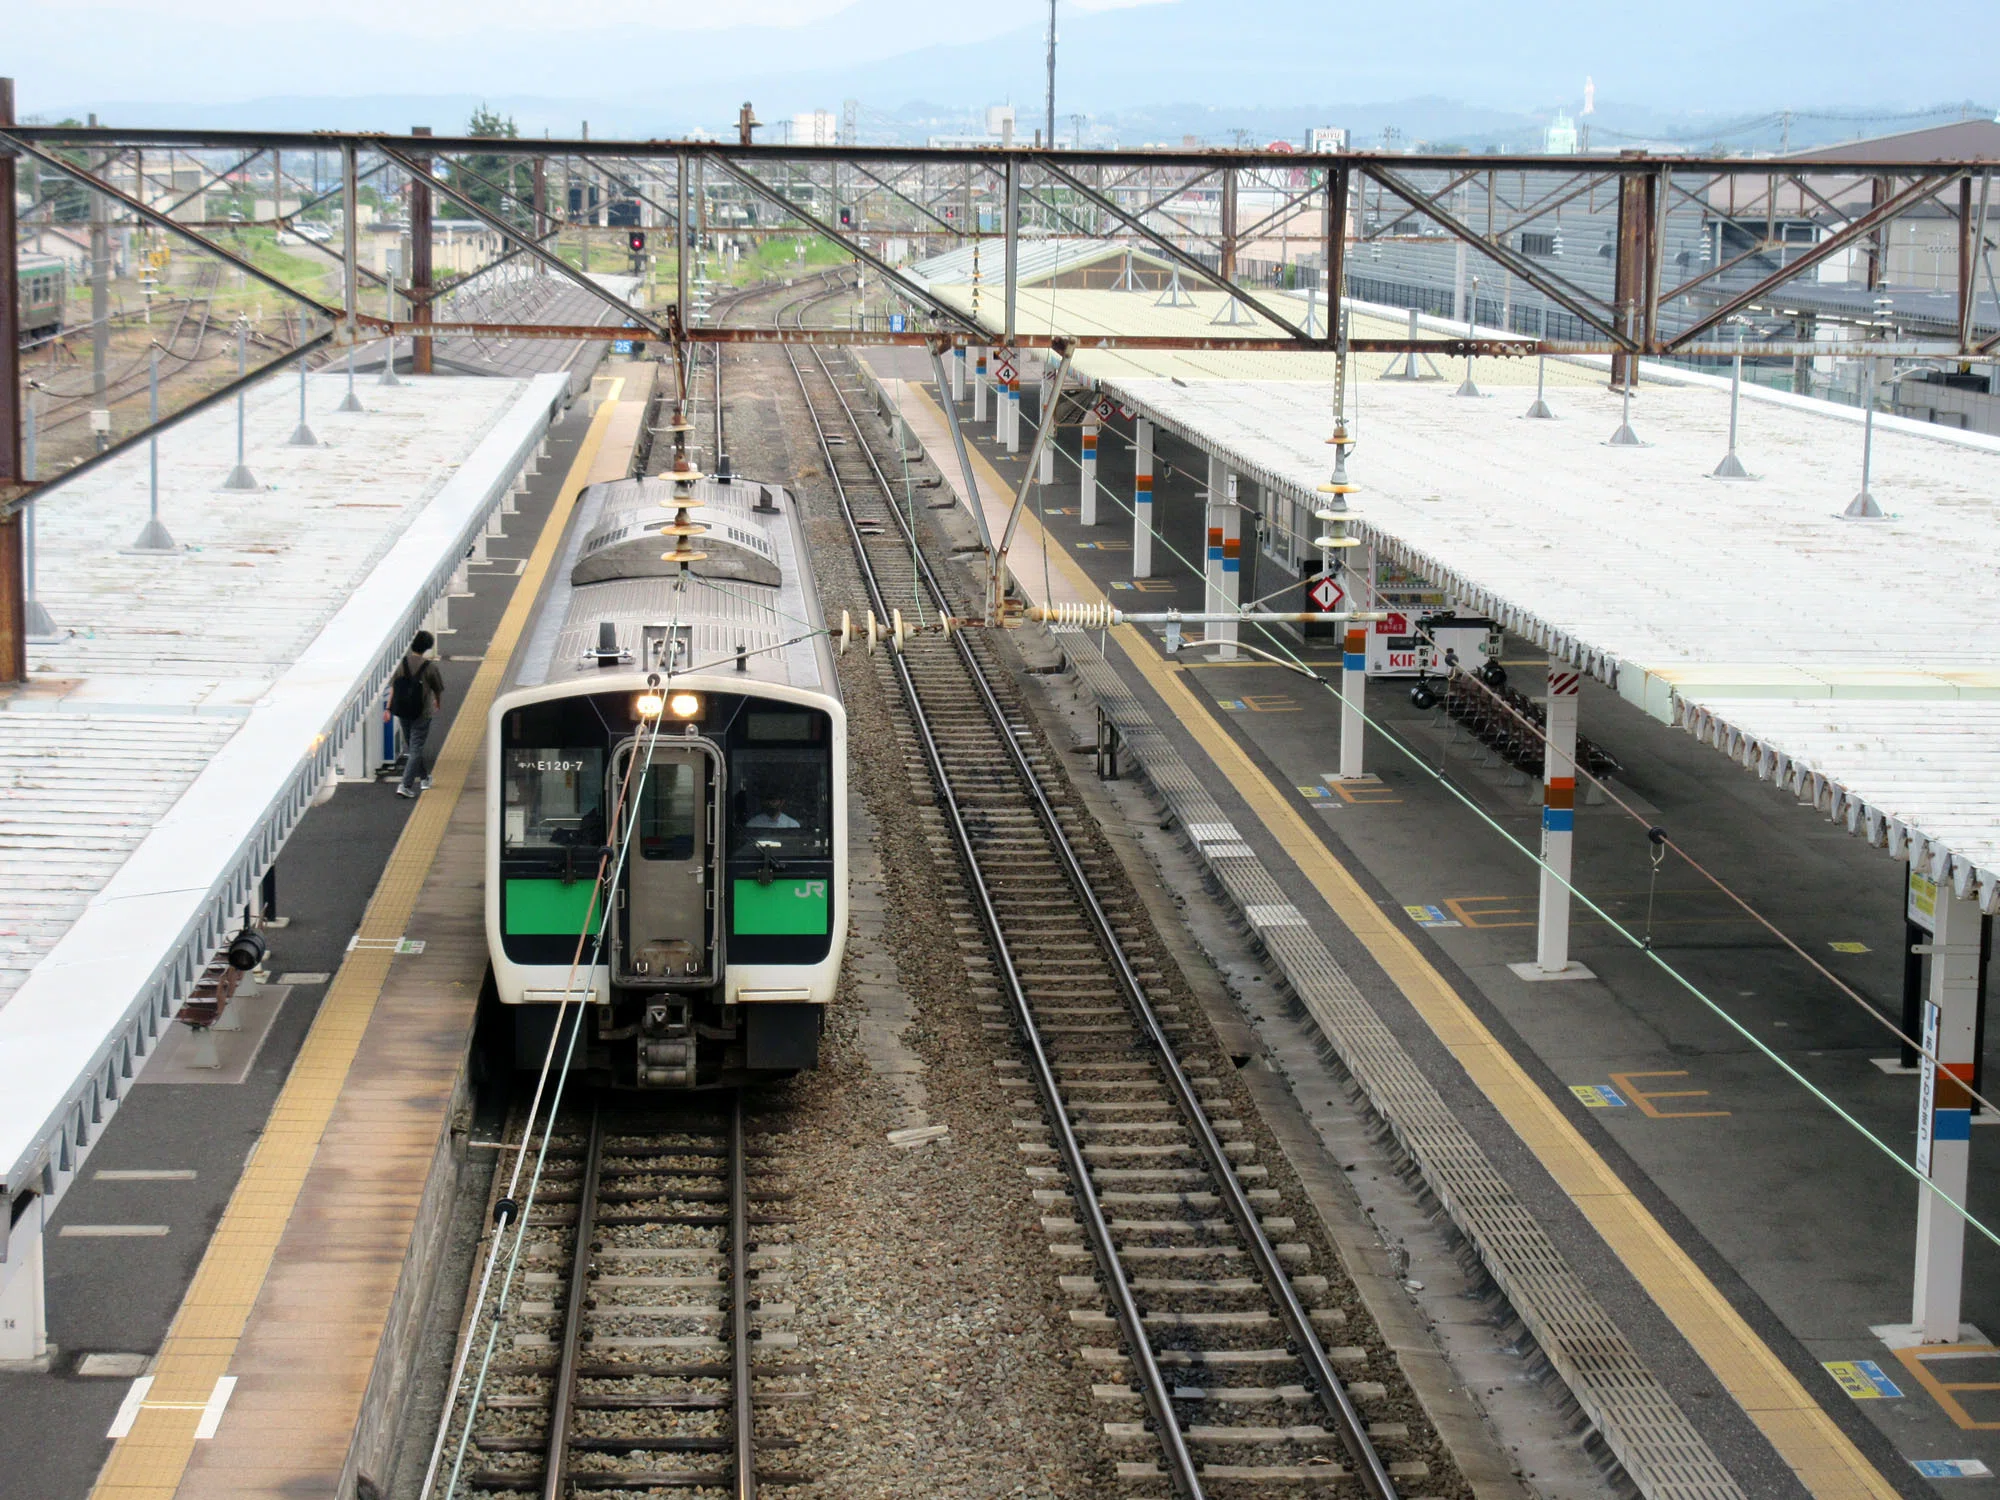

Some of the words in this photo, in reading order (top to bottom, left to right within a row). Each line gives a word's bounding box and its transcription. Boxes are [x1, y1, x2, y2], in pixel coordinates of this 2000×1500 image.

[616, 341, 630, 352] 25
[1003, 368, 1010, 379] 4
[1100, 404, 1109, 415] 3
[1488, 635, 1499, 655] 郡山
[1389, 653, 1438, 667] KIRN
[1418, 648, 1429, 667] 新津
[795, 881, 825, 898] JR
